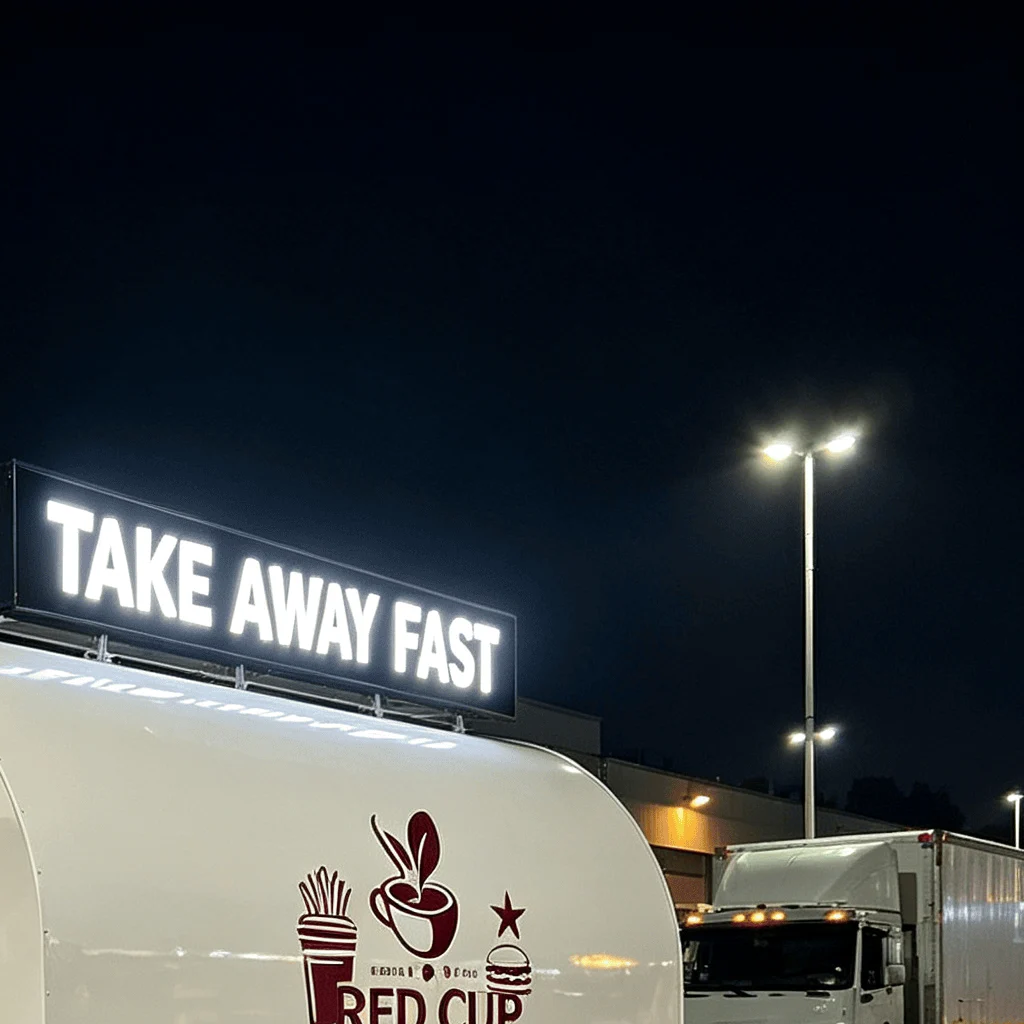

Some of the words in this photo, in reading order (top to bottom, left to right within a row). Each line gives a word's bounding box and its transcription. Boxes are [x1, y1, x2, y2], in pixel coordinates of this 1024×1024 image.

[46, 499, 213, 628] TAKE
[229, 556, 380, 665] AWAY
[393, 601, 500, 694] FAST
